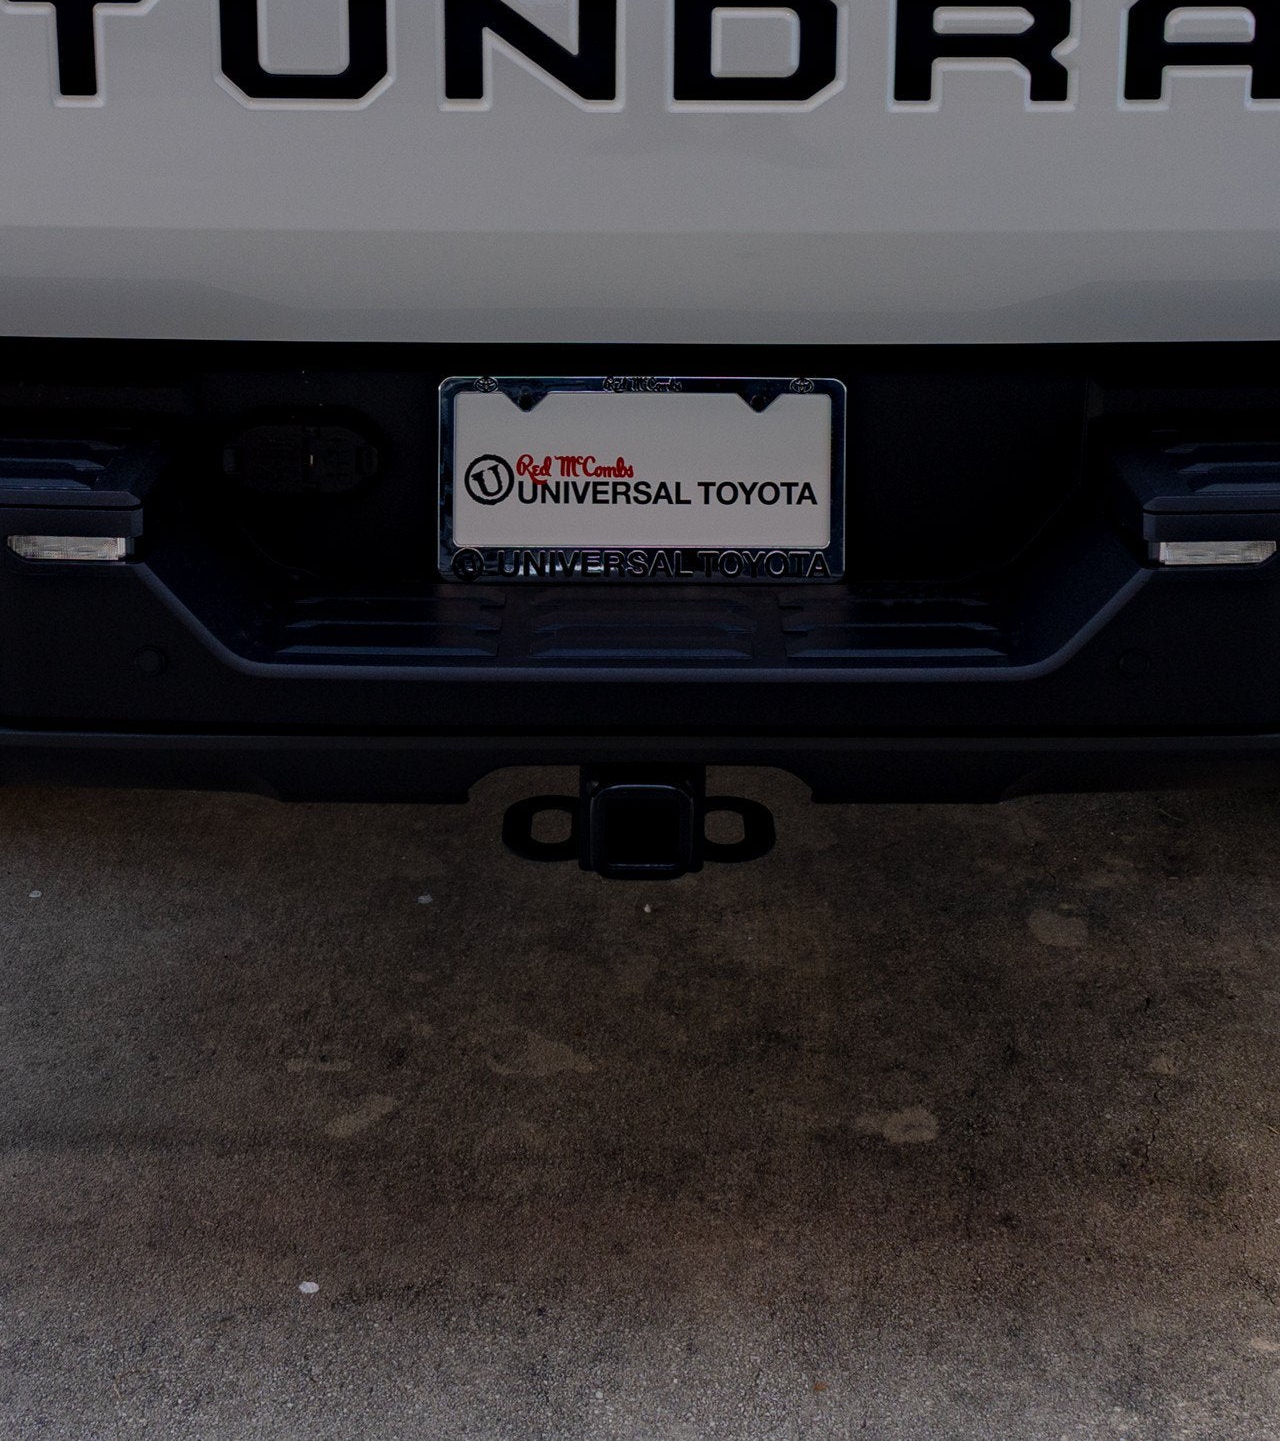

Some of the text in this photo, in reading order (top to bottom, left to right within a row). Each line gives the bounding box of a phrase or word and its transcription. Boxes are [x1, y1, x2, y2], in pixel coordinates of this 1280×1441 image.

[516, 454, 635, 485] Red McCombs
[517, 480, 818, 506] UNIVERSAL TOYOTA
[497, 549, 832, 579] UNIVERSAL TOYOTA
